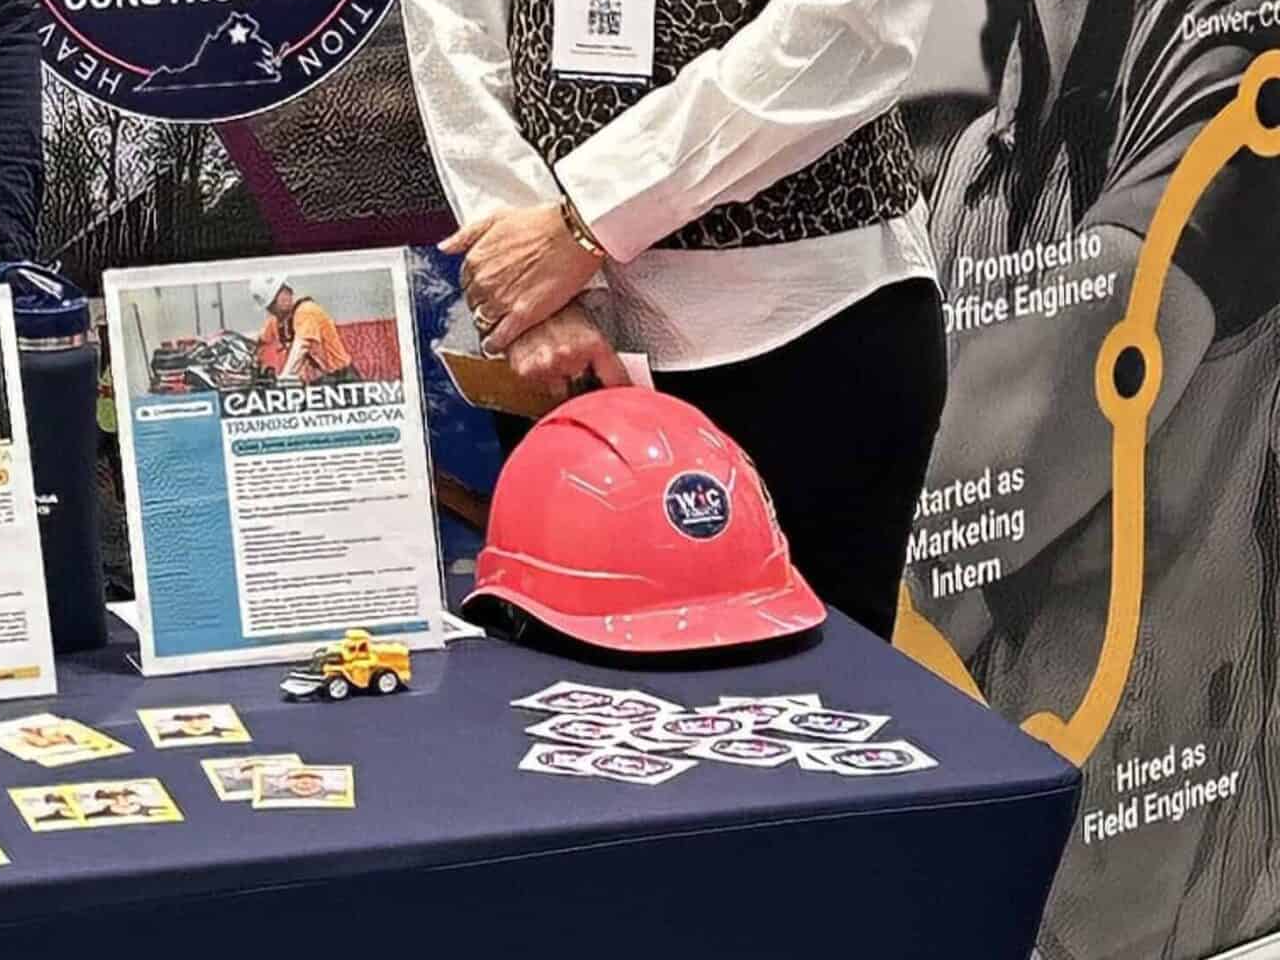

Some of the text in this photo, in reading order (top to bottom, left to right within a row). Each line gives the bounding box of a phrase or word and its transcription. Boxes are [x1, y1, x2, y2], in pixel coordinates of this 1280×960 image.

[1183, 10, 1256, 41] Denver,
[35, 19, 122, 95] HEAV
[958, 232, 1102, 289] Promoted to
[1014, 271, 1118, 318] Engineer
[224, 383, 403, 416] CARPENTRY
[226, 406, 405, 435] TRAINING WITH ABC-VA
[913, 467, 1025, 520] tarted as
[905, 507, 1025, 565] Marketing
[931, 557, 1002, 599] Intern
[1116, 742, 1207, 793] Hired as
[1082, 768, 1241, 845] Field Engineer
